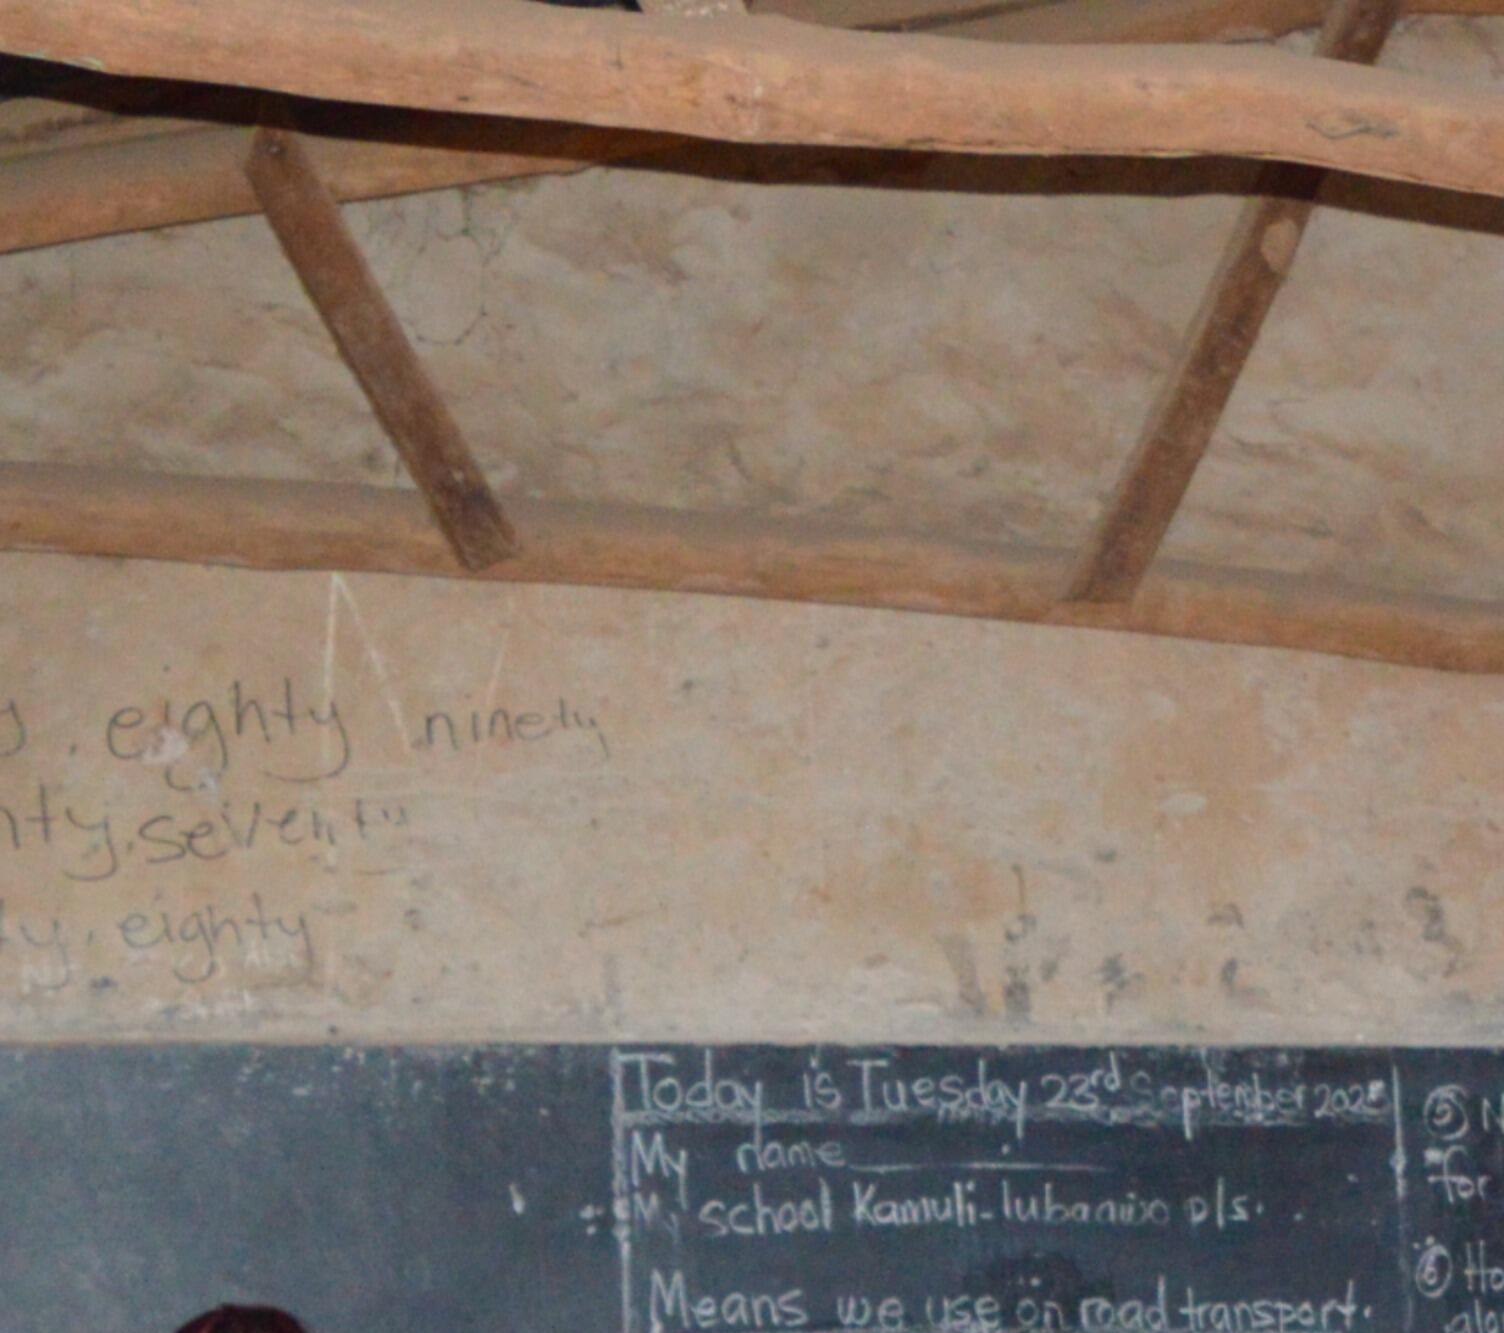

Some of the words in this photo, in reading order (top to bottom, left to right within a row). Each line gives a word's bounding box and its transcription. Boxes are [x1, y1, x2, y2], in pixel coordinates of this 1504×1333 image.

[107, 677, 350, 791] eighty
[116, 892, 316, 986] eighty
[617, 1050, 763, 1143] Today
[804, 1055, 842, 1109] is
[846, 1057, 1029, 1140] Tuesday
[629, 1128, 689, 1211] My
[735, 1140, 845, 1173] name
[698, 1177, 832, 1238] school
[1427, 1144, 1491, 1205] for
[836, 1296, 904, 1331] we
[925, 1295, 1000, 1331] use
[1015, 1298, 1067, 1330] on
[1079, 1274, 1168, 1333] road
